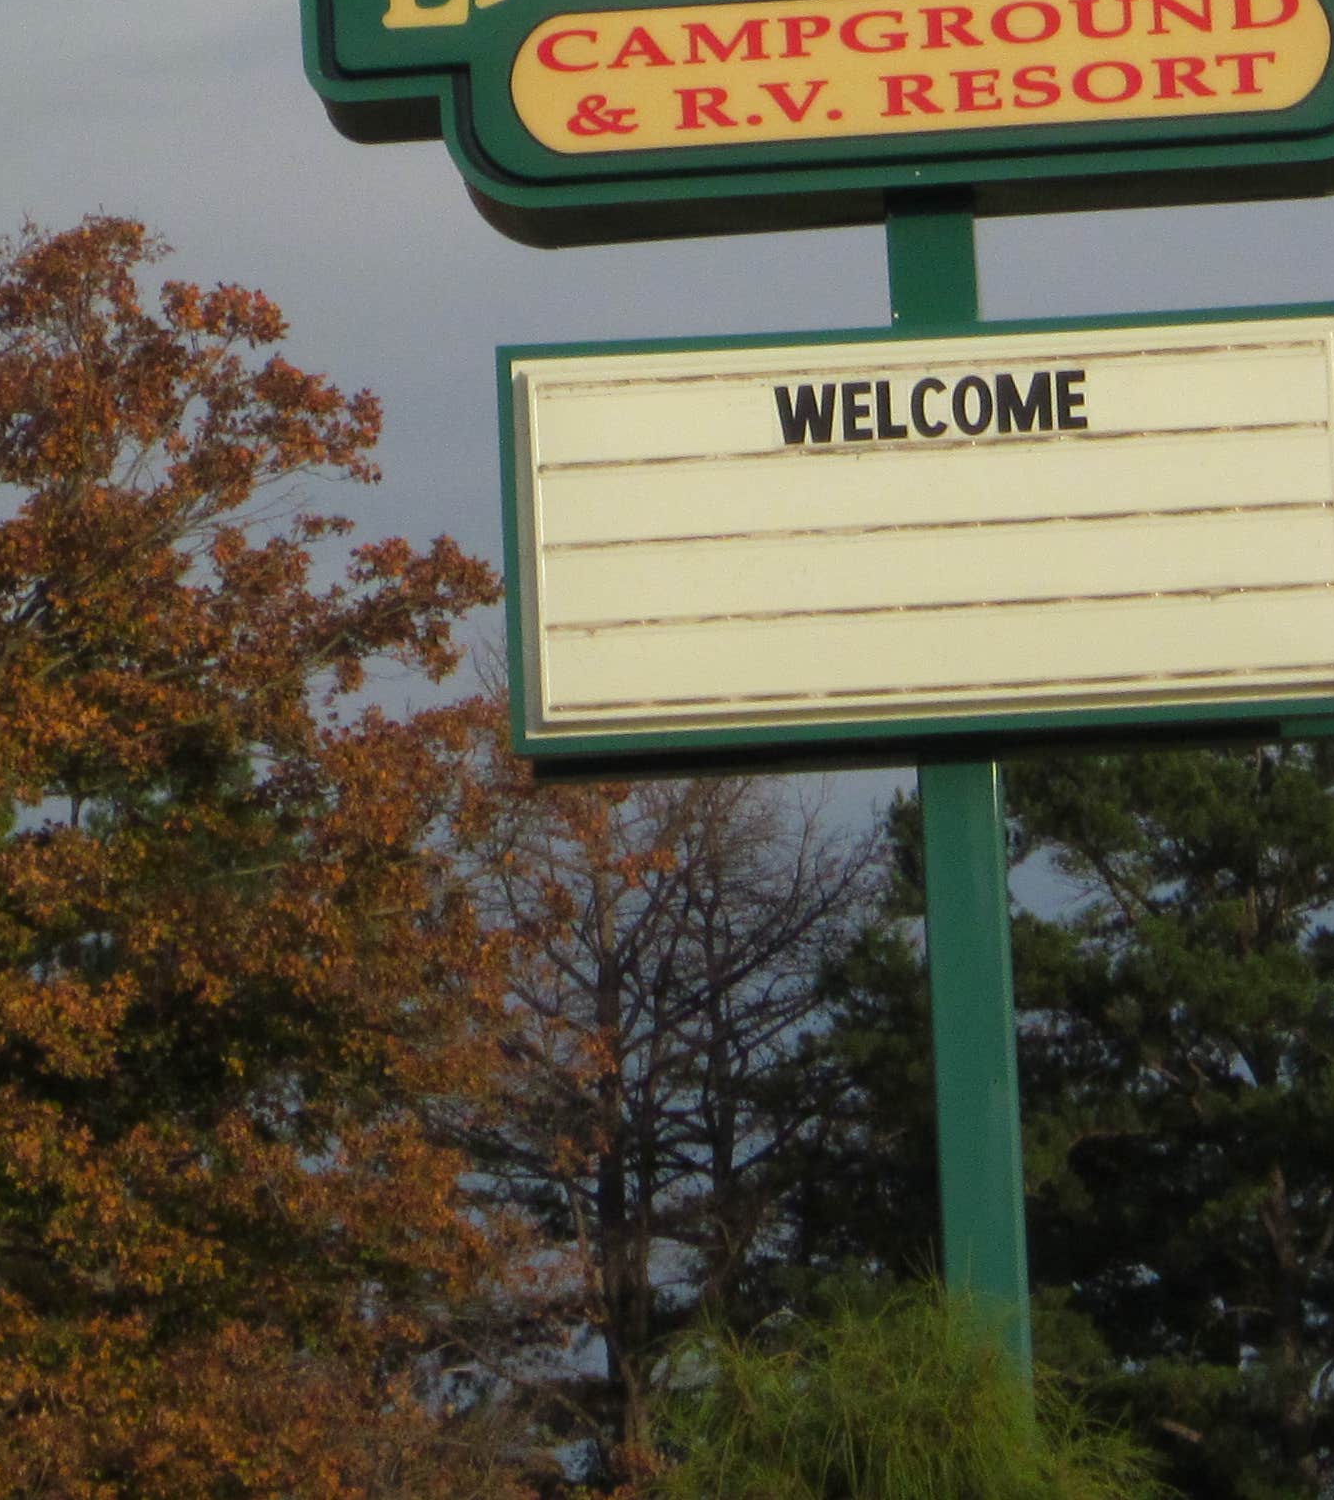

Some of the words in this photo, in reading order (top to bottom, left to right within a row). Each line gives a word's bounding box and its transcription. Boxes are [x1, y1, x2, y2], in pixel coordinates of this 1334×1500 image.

[565, 92, 641, 138] &
[673, 77, 845, 132] R.V.
[877, 50, 1279, 118] RESORT
[774, 370, 1088, 445] WELCOME
